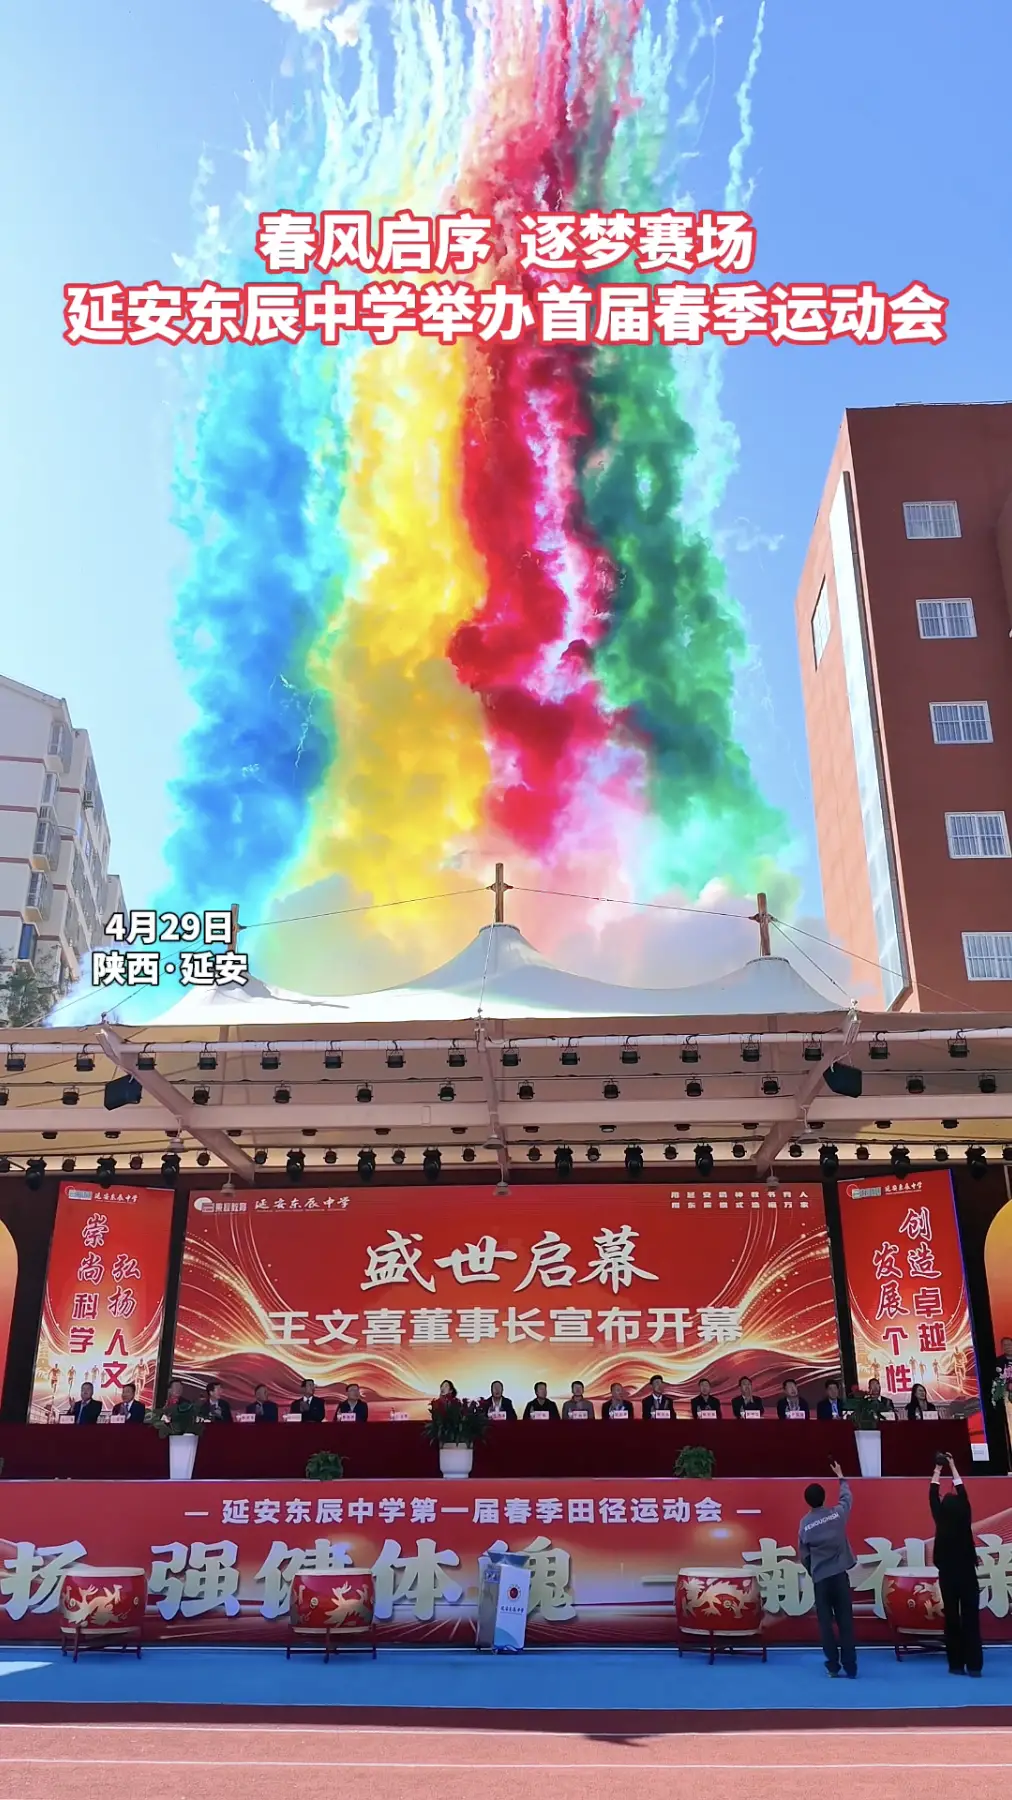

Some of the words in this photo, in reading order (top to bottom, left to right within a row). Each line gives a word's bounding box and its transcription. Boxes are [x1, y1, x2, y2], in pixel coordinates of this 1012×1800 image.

[255, 1196, 350, 1209] 延安东辰中学
[69, 1212, 109, 1354] 崇尚科学
[360, 1224, 659, 1294] 盛世启幕
[899, 1206, 947, 1353] 创造卓越
[100, 1253, 142, 1389] 弘扬人文
[265, 1306, 744, 1345] 王文喜董事长宣布开幕
[872, 1241, 914, 1394] 发展个性
[222, 1496, 722, 1524] 延安东辰中学第一届春季田径运动会
